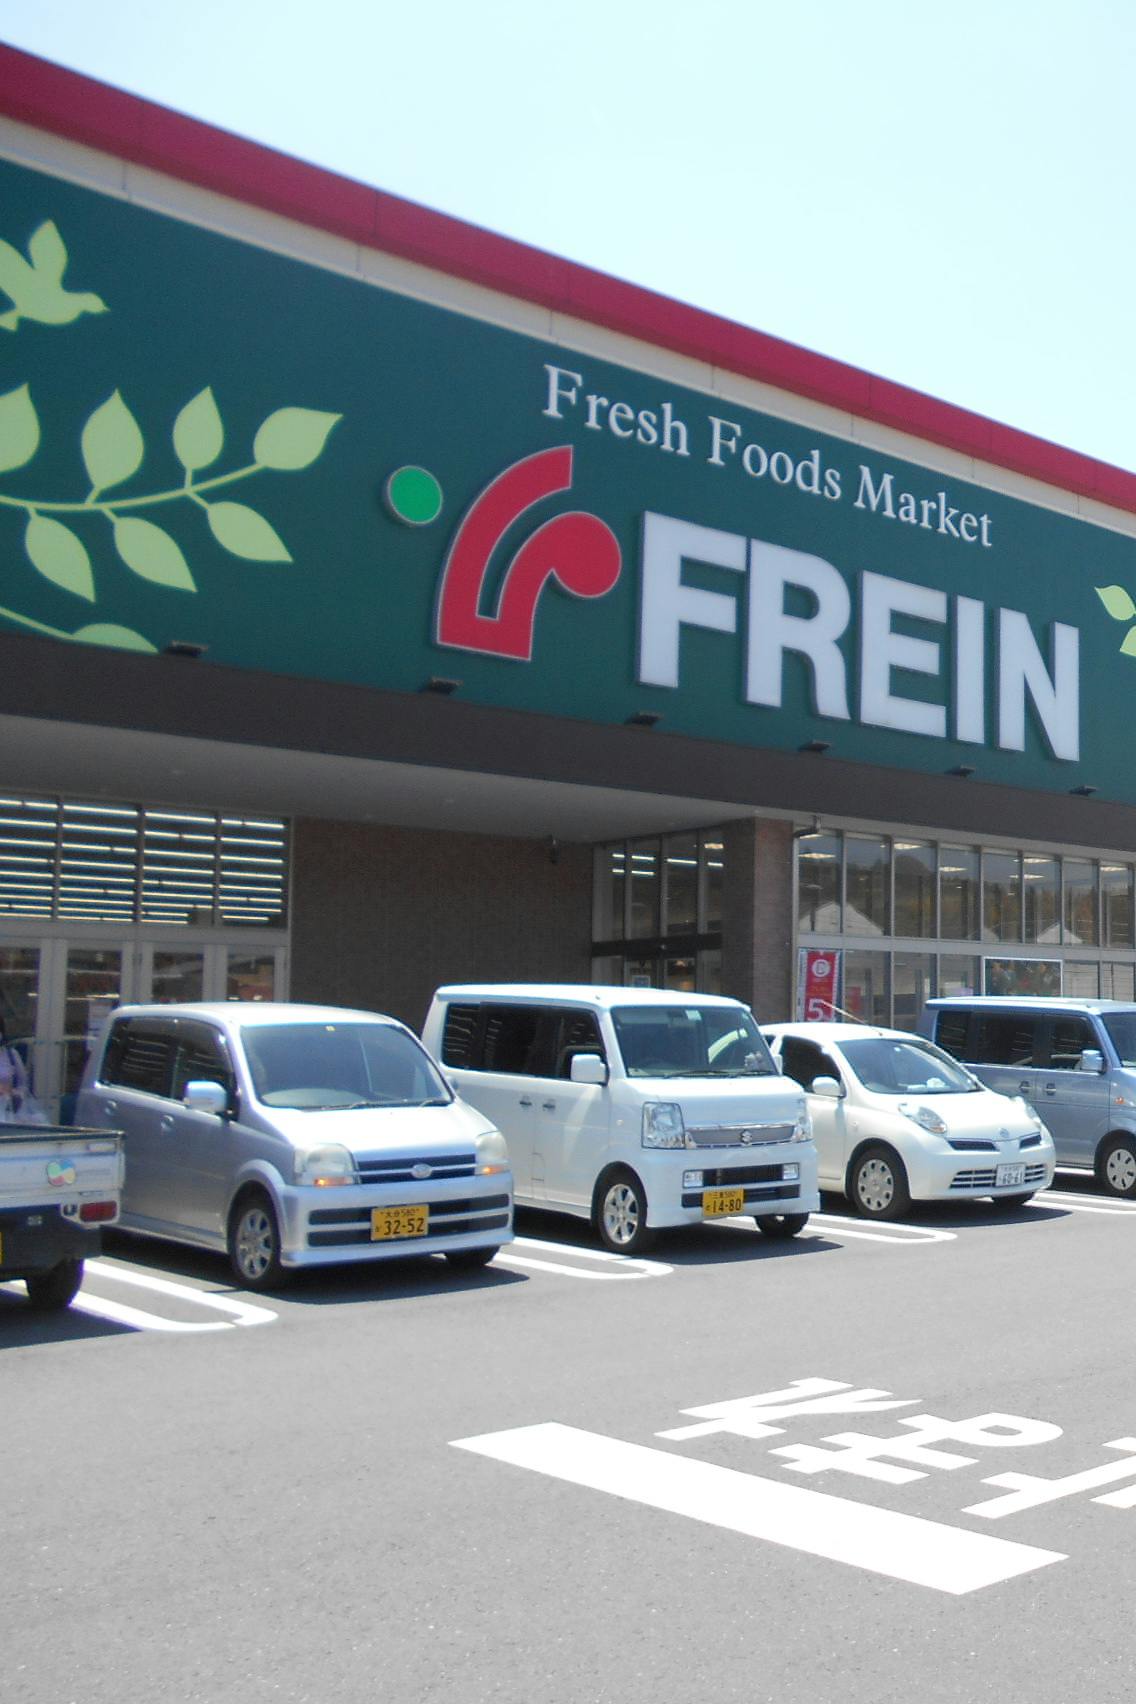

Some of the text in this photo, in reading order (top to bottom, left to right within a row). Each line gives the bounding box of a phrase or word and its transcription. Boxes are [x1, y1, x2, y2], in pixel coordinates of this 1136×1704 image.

[543, 364, 993, 548] Fresh Foods Market
[636, 510, 1080, 762] FREIN
[383, 1217, 425, 1236] 32-52
[712, 1198, 742, 1214] 14-80
